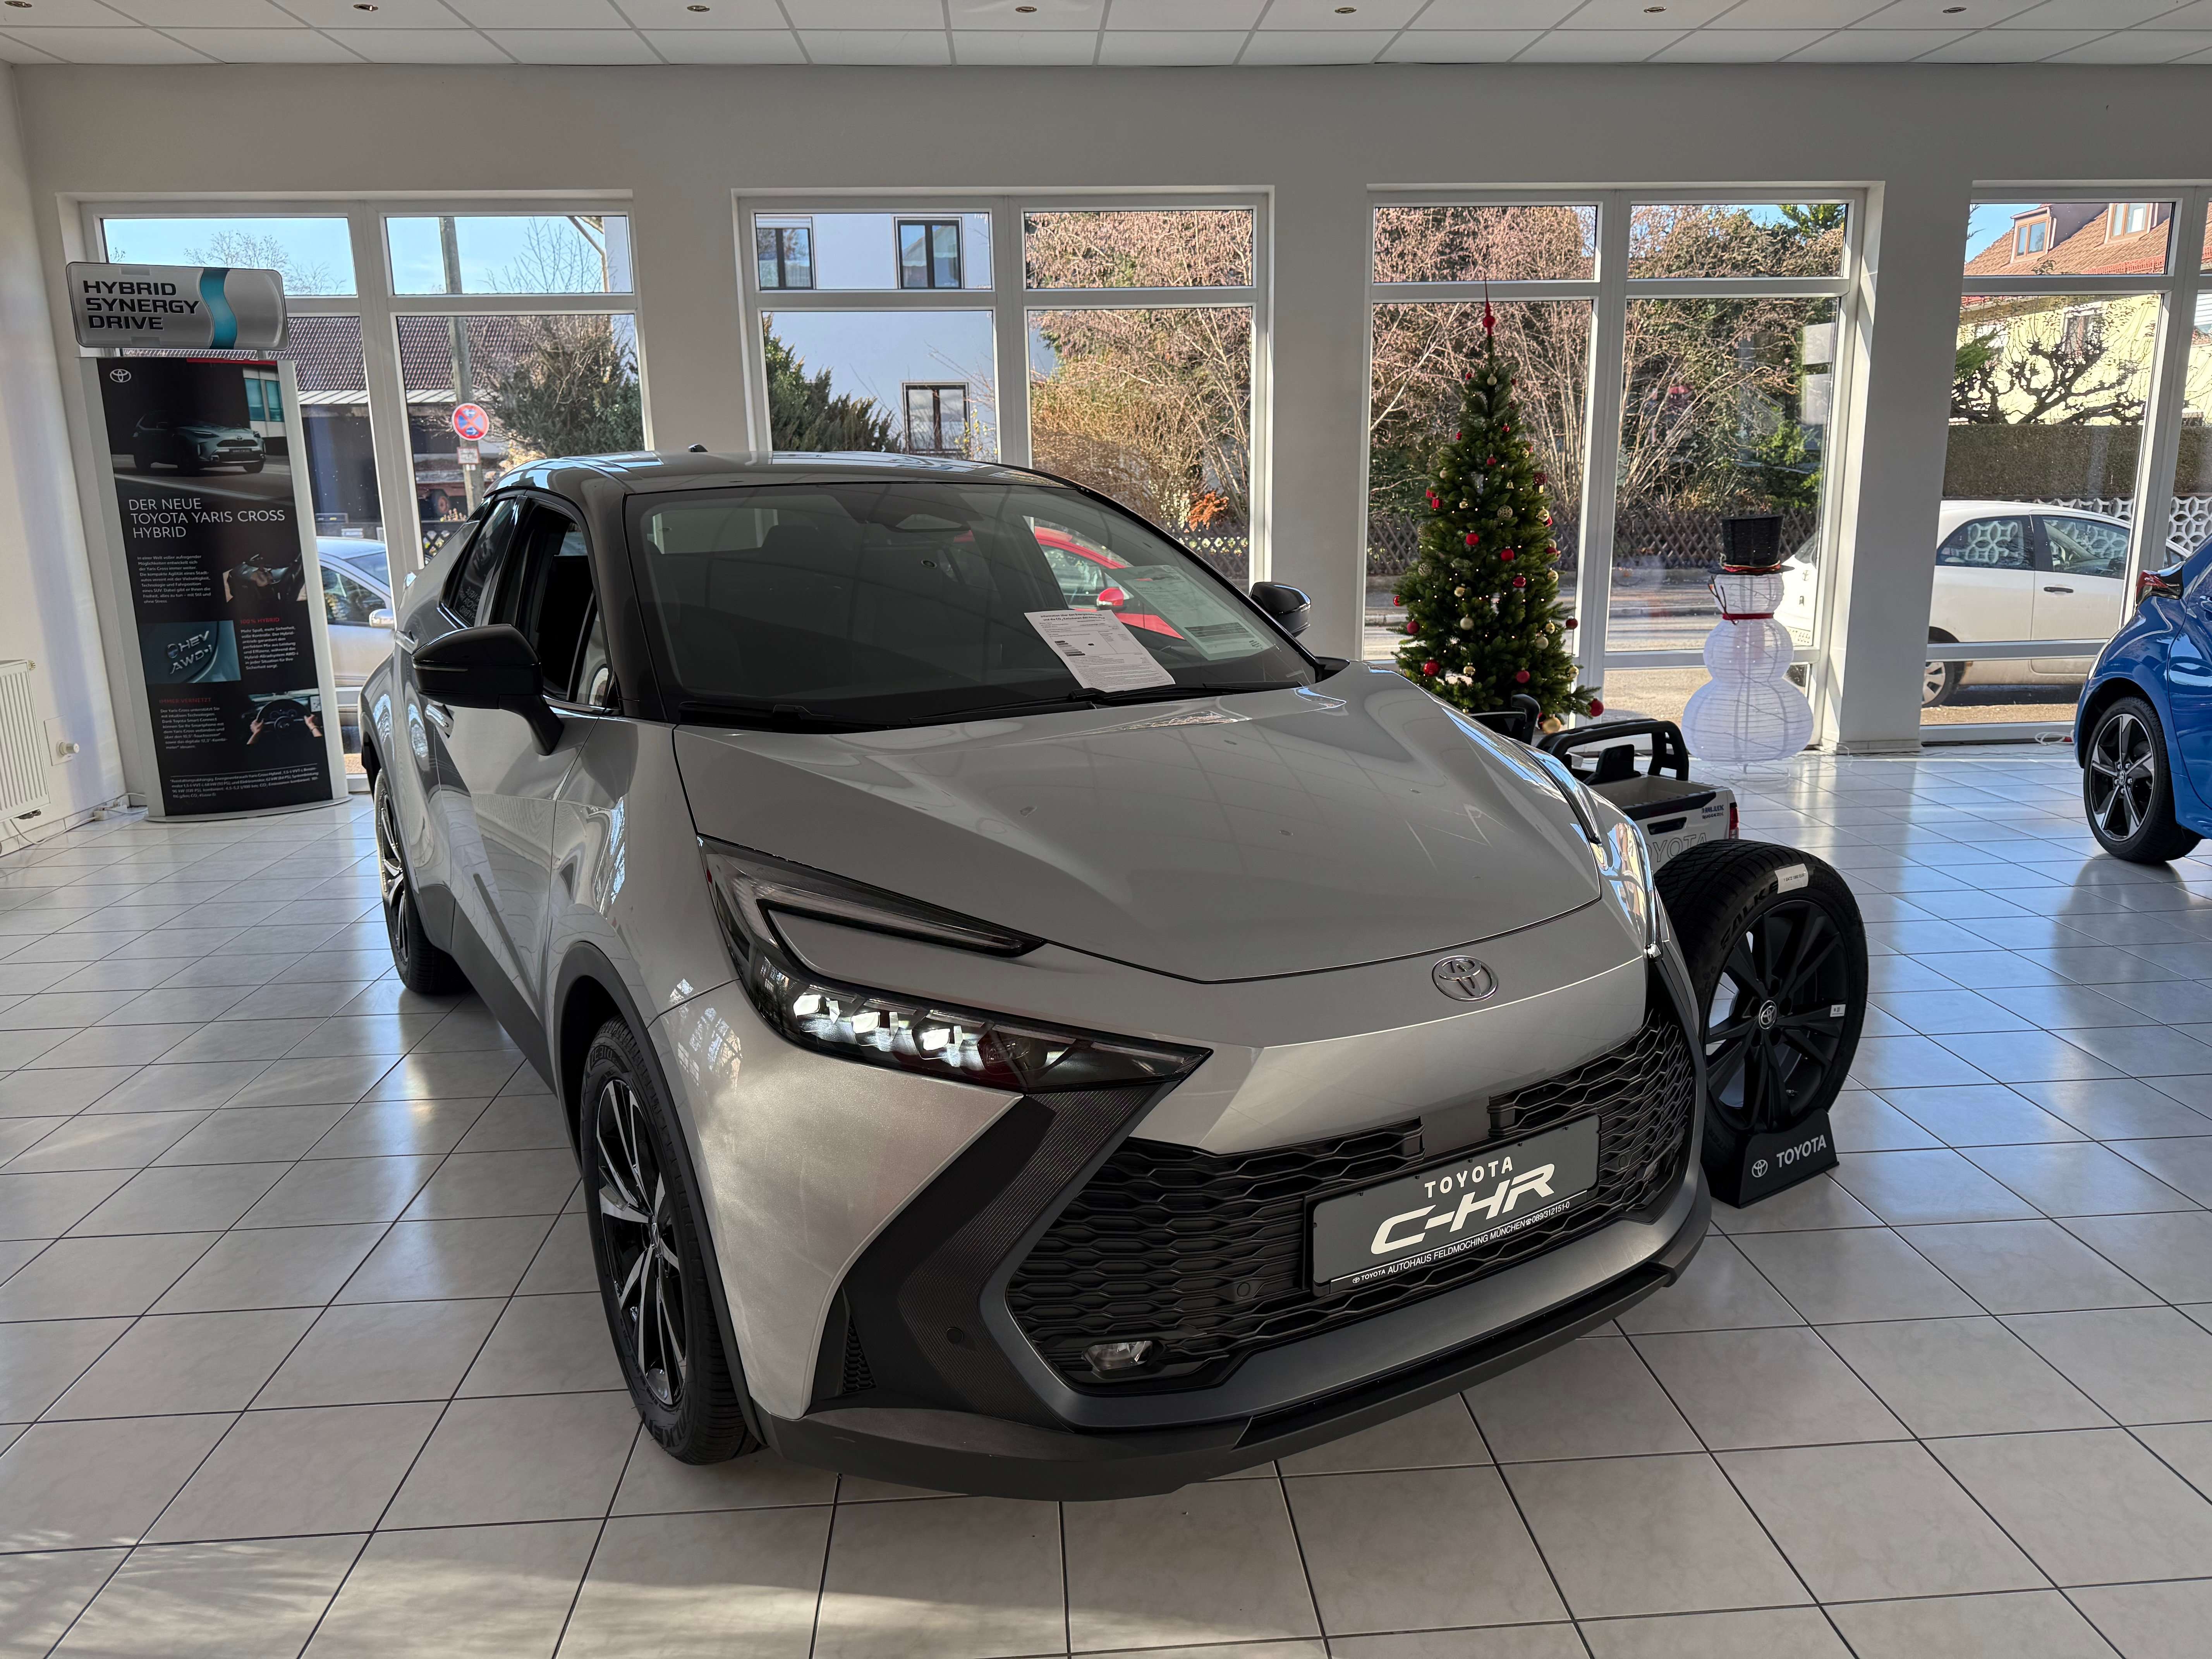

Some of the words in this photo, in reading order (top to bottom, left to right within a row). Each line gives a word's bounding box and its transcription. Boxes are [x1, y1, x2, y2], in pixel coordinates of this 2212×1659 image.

[83, 280, 176, 295] HYBRID
[86, 298, 200, 314] SYNERGY
[88, 315, 163, 330] DRIVE
[129, 499, 157, 510] DER
[162, 498, 202, 510] NEUE
[131, 512, 188, 524] TOYOTA
[192, 511, 232, 523] YARIS
[238, 510, 285, 522] CROSS
[133, 526, 186, 538] HYBRID
[1646, 833, 1707, 862] YOT
[1719, 880, 1778, 951] FALKE
[1776, 1135, 1827, 1168] TOYOTA
[1424, 1156, 1513, 1198] TOYOTA
[1371, 1164, 1555, 1254] C-HR
[1361, 1269, 1386, 1281] TOYOTA
[1388, 1254, 1432, 1274] AUTOHAUS
[1434, 1234, 1488, 1260] FELDMOCHING
[1490, 1221, 1525, 1240] MÜNCHEN
[1532, 1201, 1570, 1223] 089/312151-0
